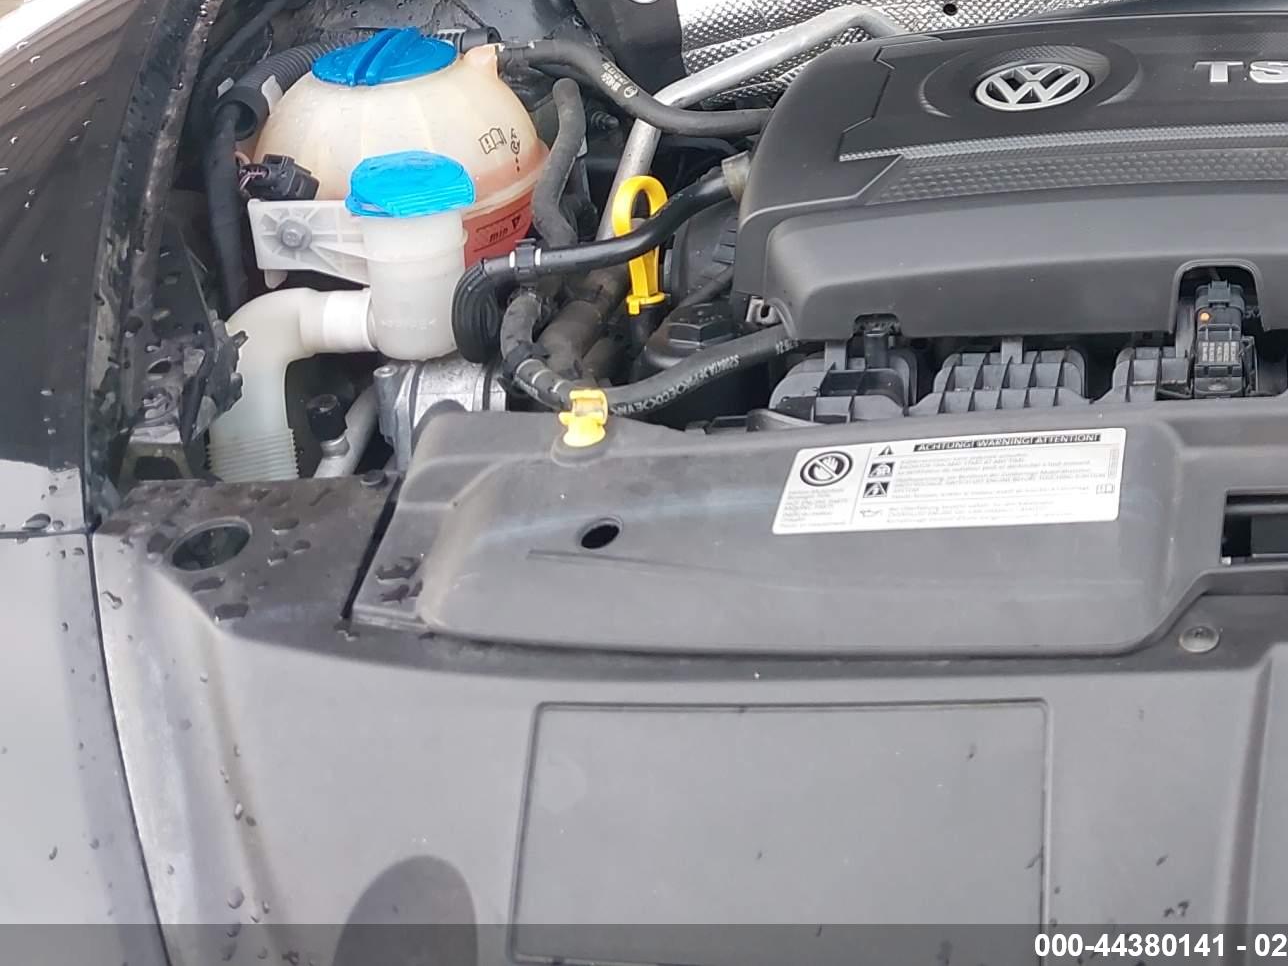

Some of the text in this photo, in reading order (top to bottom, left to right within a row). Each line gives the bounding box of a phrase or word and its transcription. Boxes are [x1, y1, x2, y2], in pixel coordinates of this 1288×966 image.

[489, 227, 508, 243] min
[918, 434, 1099, 451] ACHTUNG! WARNING! ATTENTION!
